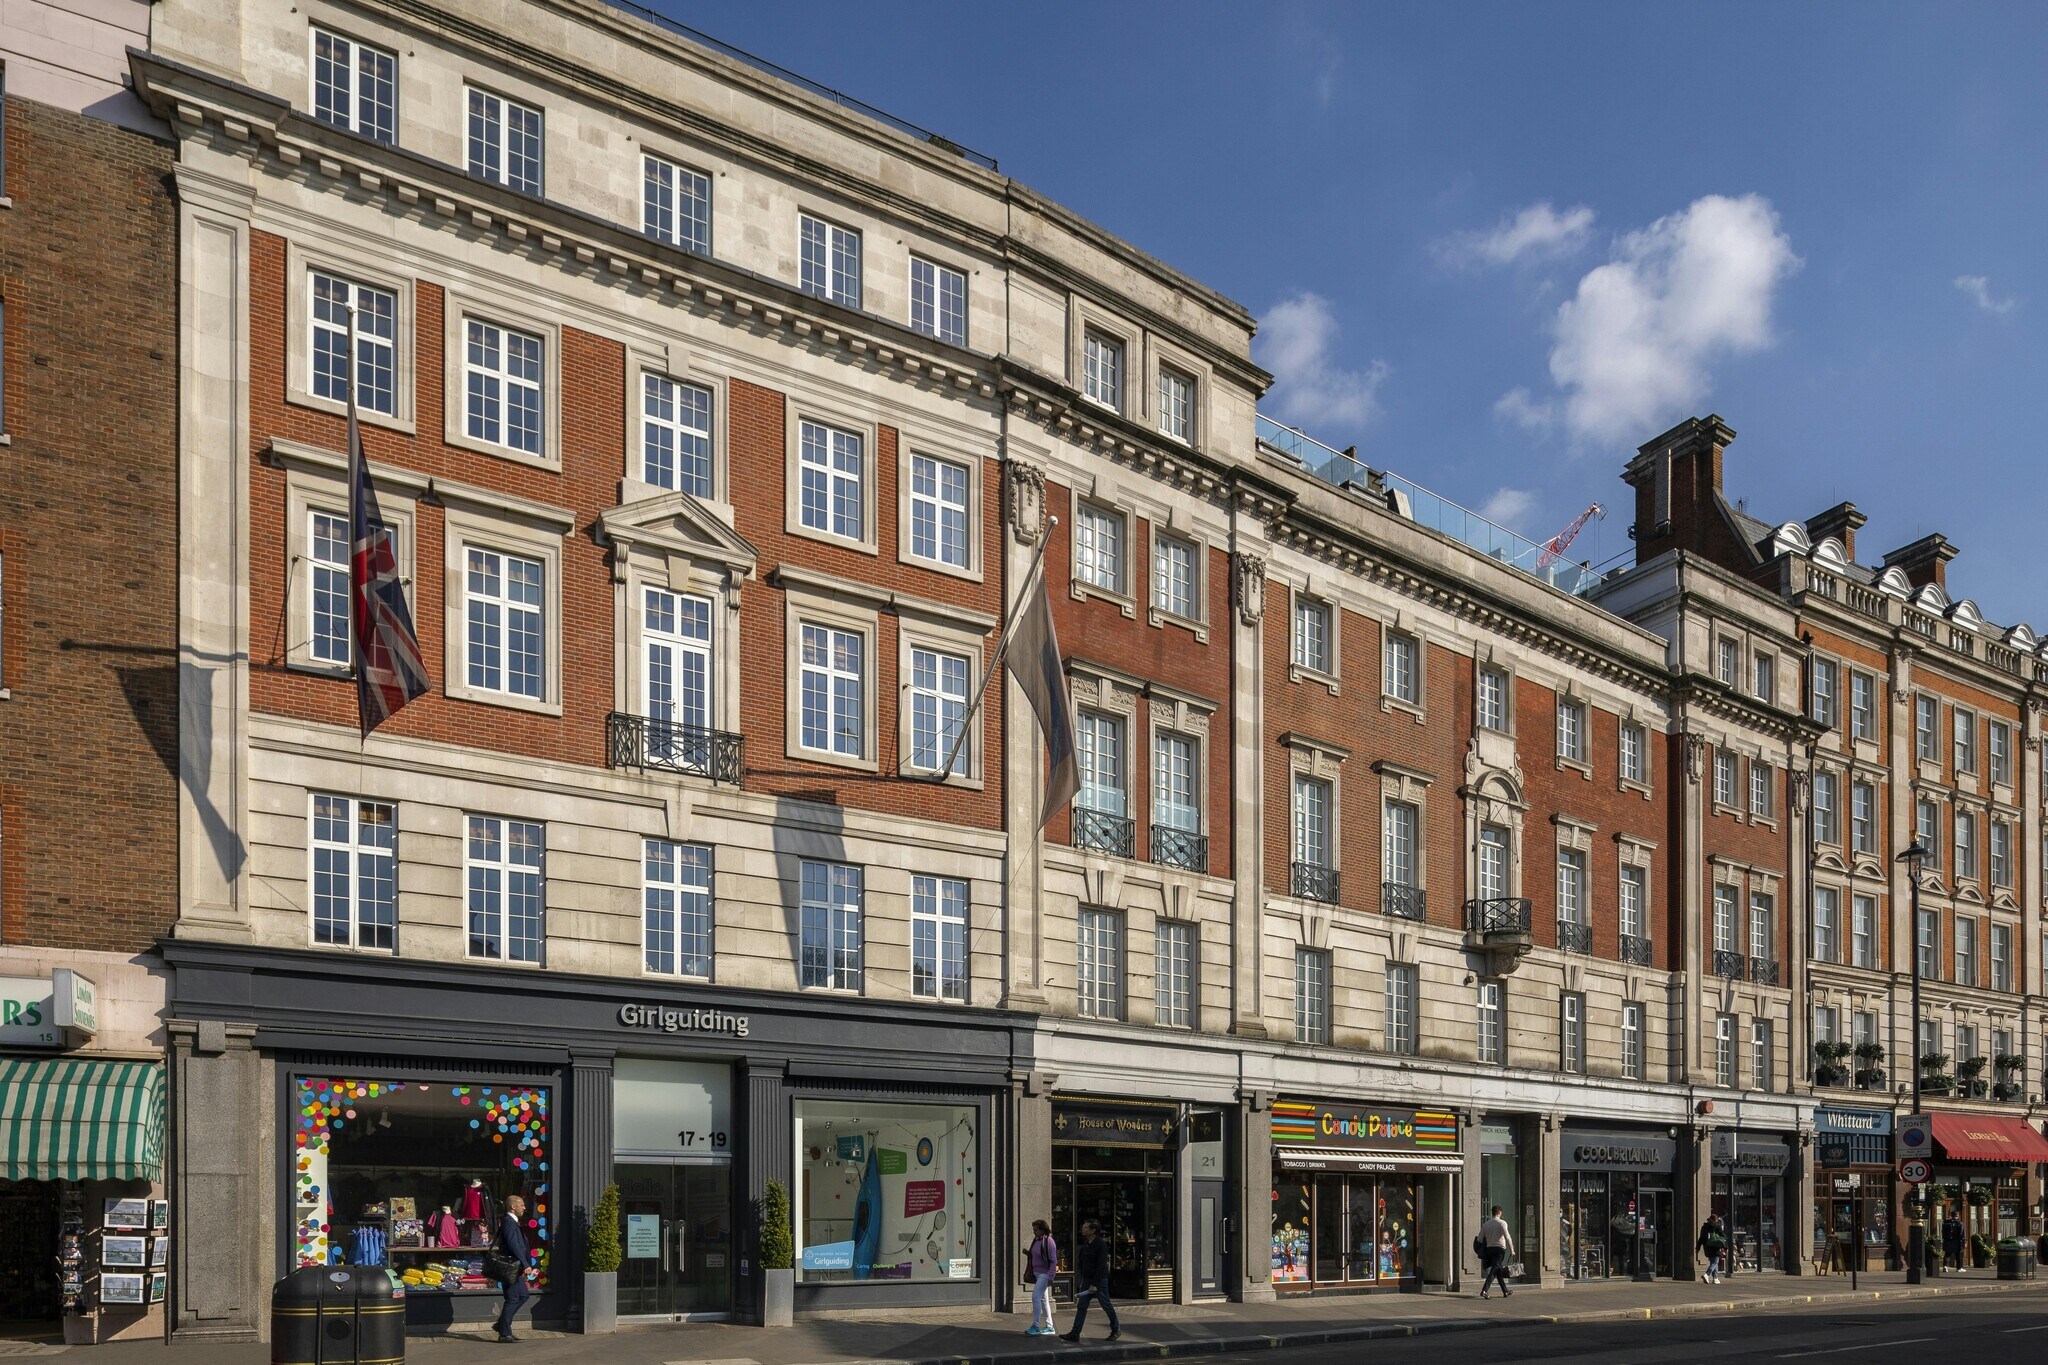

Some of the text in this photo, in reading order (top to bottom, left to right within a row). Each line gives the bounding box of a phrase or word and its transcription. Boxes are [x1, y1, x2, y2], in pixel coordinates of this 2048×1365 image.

[3, 999, 42, 1026] RS
[620, 1003, 749, 1037] Girlguiding
[40, 1033, 53, 1042] 15
[1078, 1116, 1152, 1132] House of Wonders
[1321, 1112, 1413, 1138] Candy Palace
[1827, 1111, 1873, 1129] Whittard
[678, 1131, 695, 1146] 17
[709, 1132, 727, 1147] 19
[1201, 1156, 1216, 1167] 21
[1581, 1145, 1661, 1162] COOL BRITANNIA
[1904, 1166, 1926, 1177] 30
[814, 1257, 849, 1267] Girlguiding
